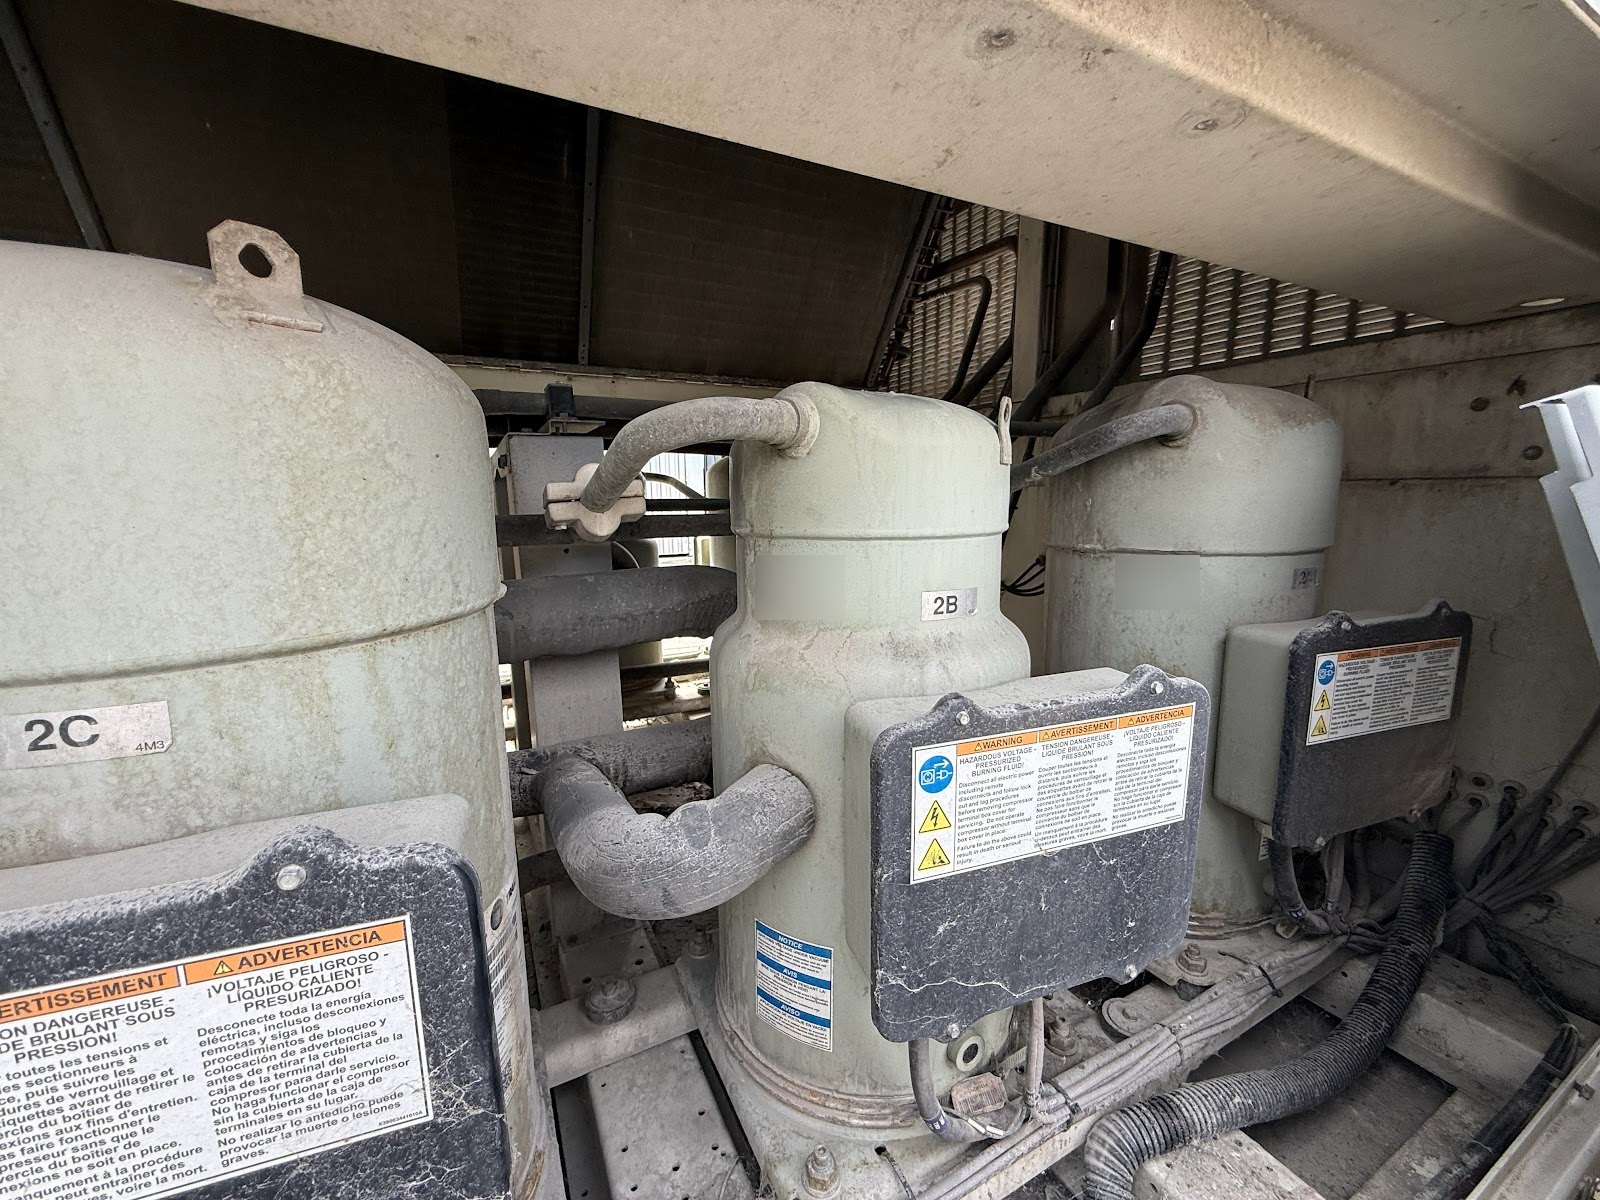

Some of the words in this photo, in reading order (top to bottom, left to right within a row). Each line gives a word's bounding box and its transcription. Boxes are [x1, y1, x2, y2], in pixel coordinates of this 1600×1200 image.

[933, 595, 958, 615] 2B
[24, 714, 100, 752] 2C
[1050, 721, 1113, 737] AVERTISSEMENT
[1135, 709, 1184, 723] ADVERTENCIA
[1150, 721, 1181, 731] PELIGROSO
[1152, 728, 1178, 737] CALIENTE
[135, 741, 165, 752] 4M3
[959, 752, 1001, 764] HAZARDOUS
[1003, 746, 1032, 757] VOLTAGE
[982, 736, 1022, 748] WARNING
[1041, 748, 1064, 757] LIQUIDE
[1068, 742, 1095, 752] BRULANT
[1097, 739, 1112, 747] SOUS
[1042, 740, 1068, 750] TENSION
[1070, 733, 1110, 745] DANGEREUSE
[971, 766, 1001, 776] BURNING
[975, 755, 1021, 769] PRESSURIZED
[237, 930, 382, 970] ADVERTENCIA
[778, 935, 803, 950] NOTICE
[207, 970, 285, 998] ¡VOLTAJE
[289, 951, 379, 978] PELIGROSO
[227, 981, 294, 1004] LÍQUIDO
[298, 963, 374, 988] CALIENTE
[783, 969, 798, 979] AVIS
[244, 978, 361, 1012] PRESURIZADO!
[780, 1004, 801, 1018] AVISO
[29, 1018, 120, 1047] BRULANT
[125, 1006, 175, 1026] SOUS
[33, 996, 164, 1033] DANGEREUSE
[197, 1013, 276, 1037] Desconecte
[279, 1006, 308, 1018] toda
[311, 1003, 322, 1011] la
[325, 991, 371, 1007] energía
[198, 1028, 260, 1047] eléctrica,
[263, 1016, 310, 1032] incluso
[314, 994, 405, 1020] desconexiones
[14, 1032, 117, 1064] PRESSION!
[201, 1039, 255, 1057] remotas
[259, 1036, 266, 1045] y
[270, 1029, 297, 1040] siga
[301, 1024, 320, 1034] los
[203, 1037, 305, 1069] procedimientos
[308, 1032, 323, 1041] de
[327, 1020, 376, 1037] bloqueo
[379, 1018, 386, 1027] y
[204, 1054, 277, 1077] colocación
[280, 1049, 296, 1058] de
[299, 1030, 377, 1054] advertencias
[5, 1064, 55, 1081] toutes
[59, 1058, 82, 1068] les
[86, 1042, 150, 1062] tensions
[154, 1037, 168, 1047] et
[25, 1059, 124, 1087] sectionneurs
[128, 1054, 137, 1063] à
[206, 1072, 243, 1087] antes
[246, 1067, 262, 1077] de
[266, 1057, 305, 1072] retirar
[308, 1053, 319, 1062] la
[322, 1041, 372, 1058] cubierta
[375, 1036, 389, 1045] de
[392, 1033, 403, 1041] la
[208, 1084, 235, 1097] caja
[239, 1080, 255, 1089] de
[259, 1076, 270, 1084] la
[273, 1060, 325, 1080] terminal
[328, 1055, 347, 1066] del
[25, 1085, 58, 1101] puis
[62, 1073, 109, 1090] suivre
[113, 1067, 135, 1078] les
[45, 1095, 64, 1105] de
[68, 1073, 156, 1099] verrouillage
[160, 1067, 174, 1077] et
[69, 1093, 110, 1110] avant
[113, 1090, 131, 1099] de
[135, 1077, 179, 1094] retirer
[182, 1074, 194, 1083] le
[210, 1082, 281, 1106] compresor
[284, 1075, 312, 1089] para
[315, 1066, 346, 1079] darle
[349, 1054, 399, 1070] servicio.
[211, 1106, 230, 1116] No
[234, 1097, 266, 1110] haga
[269, 1080, 329, 1101] funcionar
[332, 1075, 343, 1084] el
[346, 1059, 410, 1081] compresor
[38, 1118, 57, 1129] du
[62, 1105, 110, 1123] boîtier
[114, 1100, 132, 1110] de
[55, 1123, 82, 1136] aux
[86, 1115, 114, 1128] fins
[118, 1095, 197, 1119] d'entretien.
[213, 1115, 233, 1126] sin
[237, 1111, 249, 1120] la
[252, 1097, 304, 1115] cubierta
[307, 1092, 323, 1101] de
[326, 1088, 337, 1096] la
[340, 1080, 365, 1092] caja
[368, 1076, 382, 1085] de
[214, 1112, 283, 1135] terminales
[286, 1107, 302, 1116] en
[305, 1102, 321, 1111] su
[324, 1092, 358, 1106] lugar.
[20, 1141, 54, 1156] faire
[58, 1118, 144, 1145] fonctionner
[147, 1114, 160, 1123] le
[217, 1137, 236, 1147] No
[239, 1123, 287, 1141] realizar
[290, 1119, 302, 1127] lo
[305, 1099, 365, 1123] antedicho
[376, 1091, 403, 1104] puede
[219, 1135, 277, 1159] provocar
[280, 1131, 292, 1140] la
[295, 1119, 338, 1136] muerte
[352, 1099, 401, 1119] lesiones
[48, 1159, 67, 1170] du
[71, 1145, 119, 1164] boîtier
[123, 1140, 140, 1150] de
[71, 1139, 106, 1153] sans
[110, 1130, 137, 1143] que
[141, 1126, 154, 1135] le
[64, 1166, 82, 1176] ne
[87, 1156, 115, 1170] soit
[118, 1152, 136, 1161] en
[140, 1141, 181, 1158] place.
[103, 1170, 111, 1179] à
[115, 1167, 128, 1176] la
[132, 1146, 202, 1173] procédure
[221, 1149, 268, 1168] graves.
[92, 1169, 156, 1192] entraîner
[160, 1161, 185, 1173] des
[116, 1181, 151, 1195] voire
[155, 1176, 168, 1185] la
[172, 1164, 207, 1180] mort.
